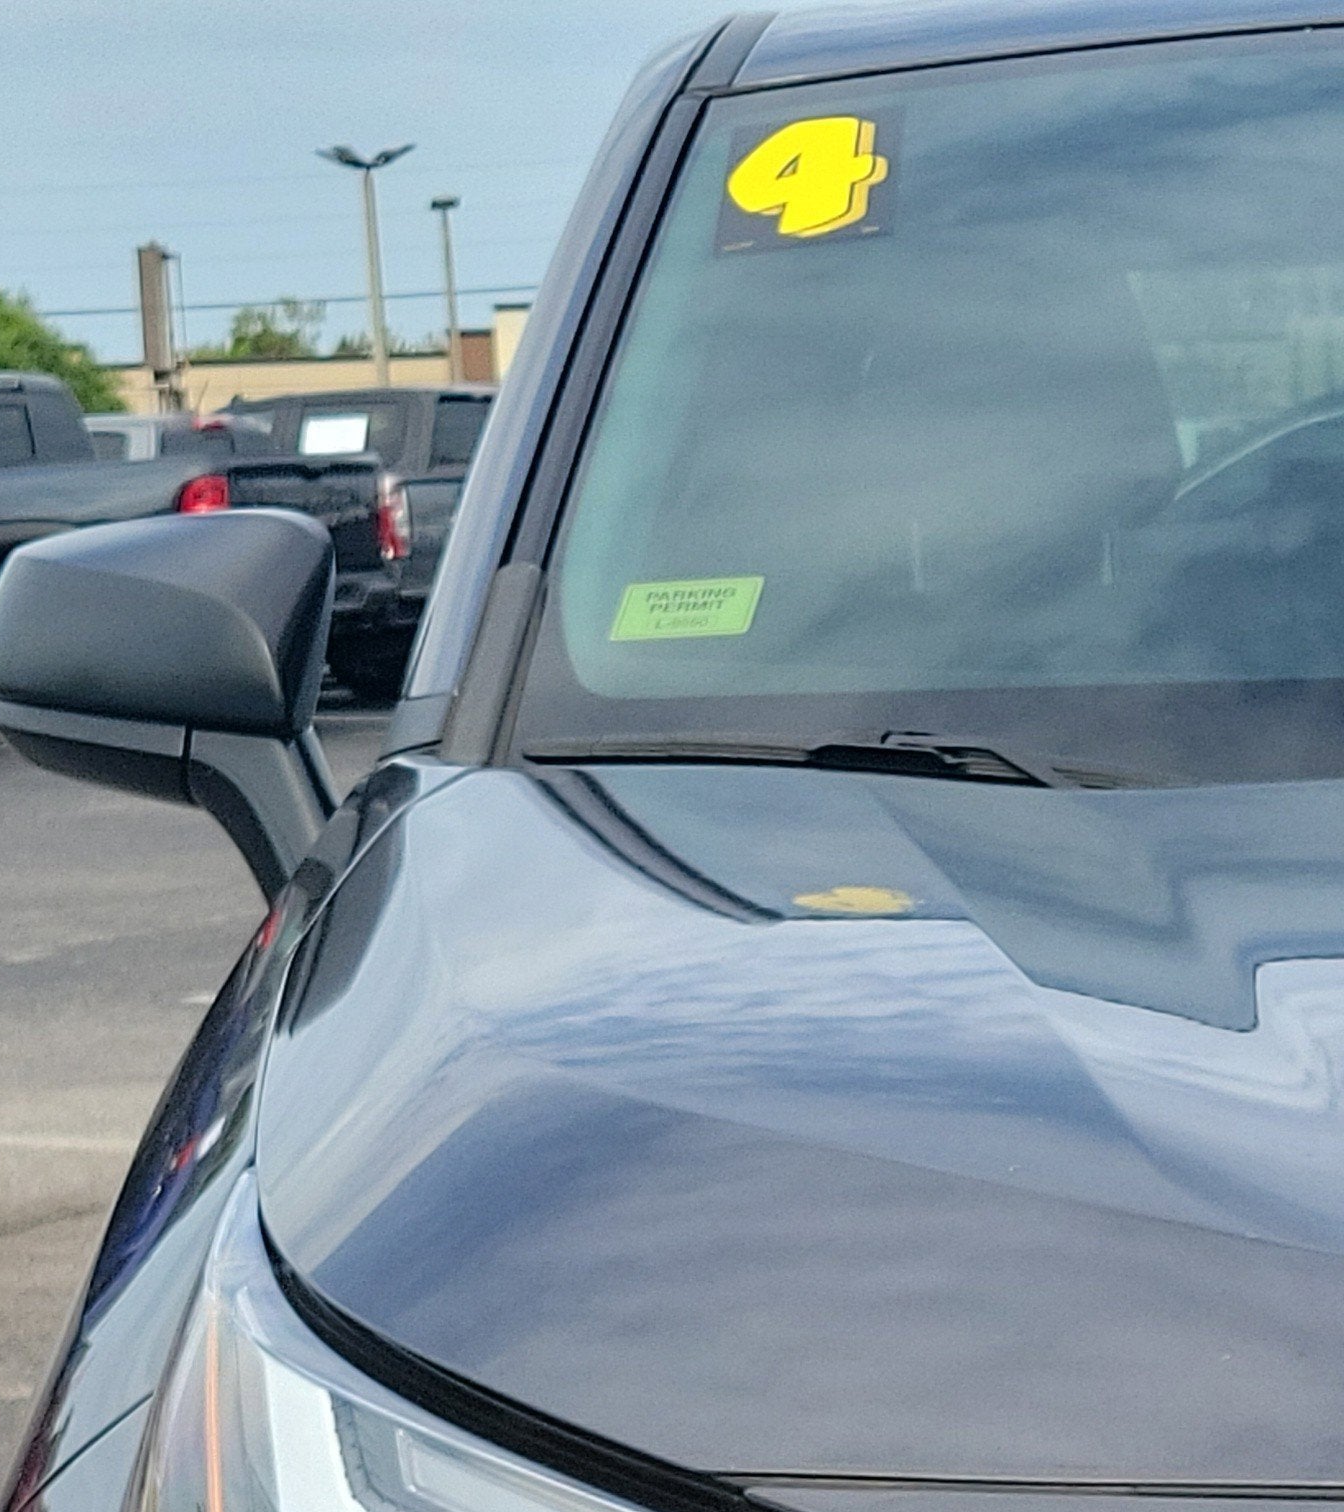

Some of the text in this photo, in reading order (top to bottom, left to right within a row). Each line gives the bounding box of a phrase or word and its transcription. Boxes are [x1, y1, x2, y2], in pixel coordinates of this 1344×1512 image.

[727, 116, 889, 238] 4
[647, 588, 737, 602] PARKING
[651, 600, 724, 613] PERMIT
